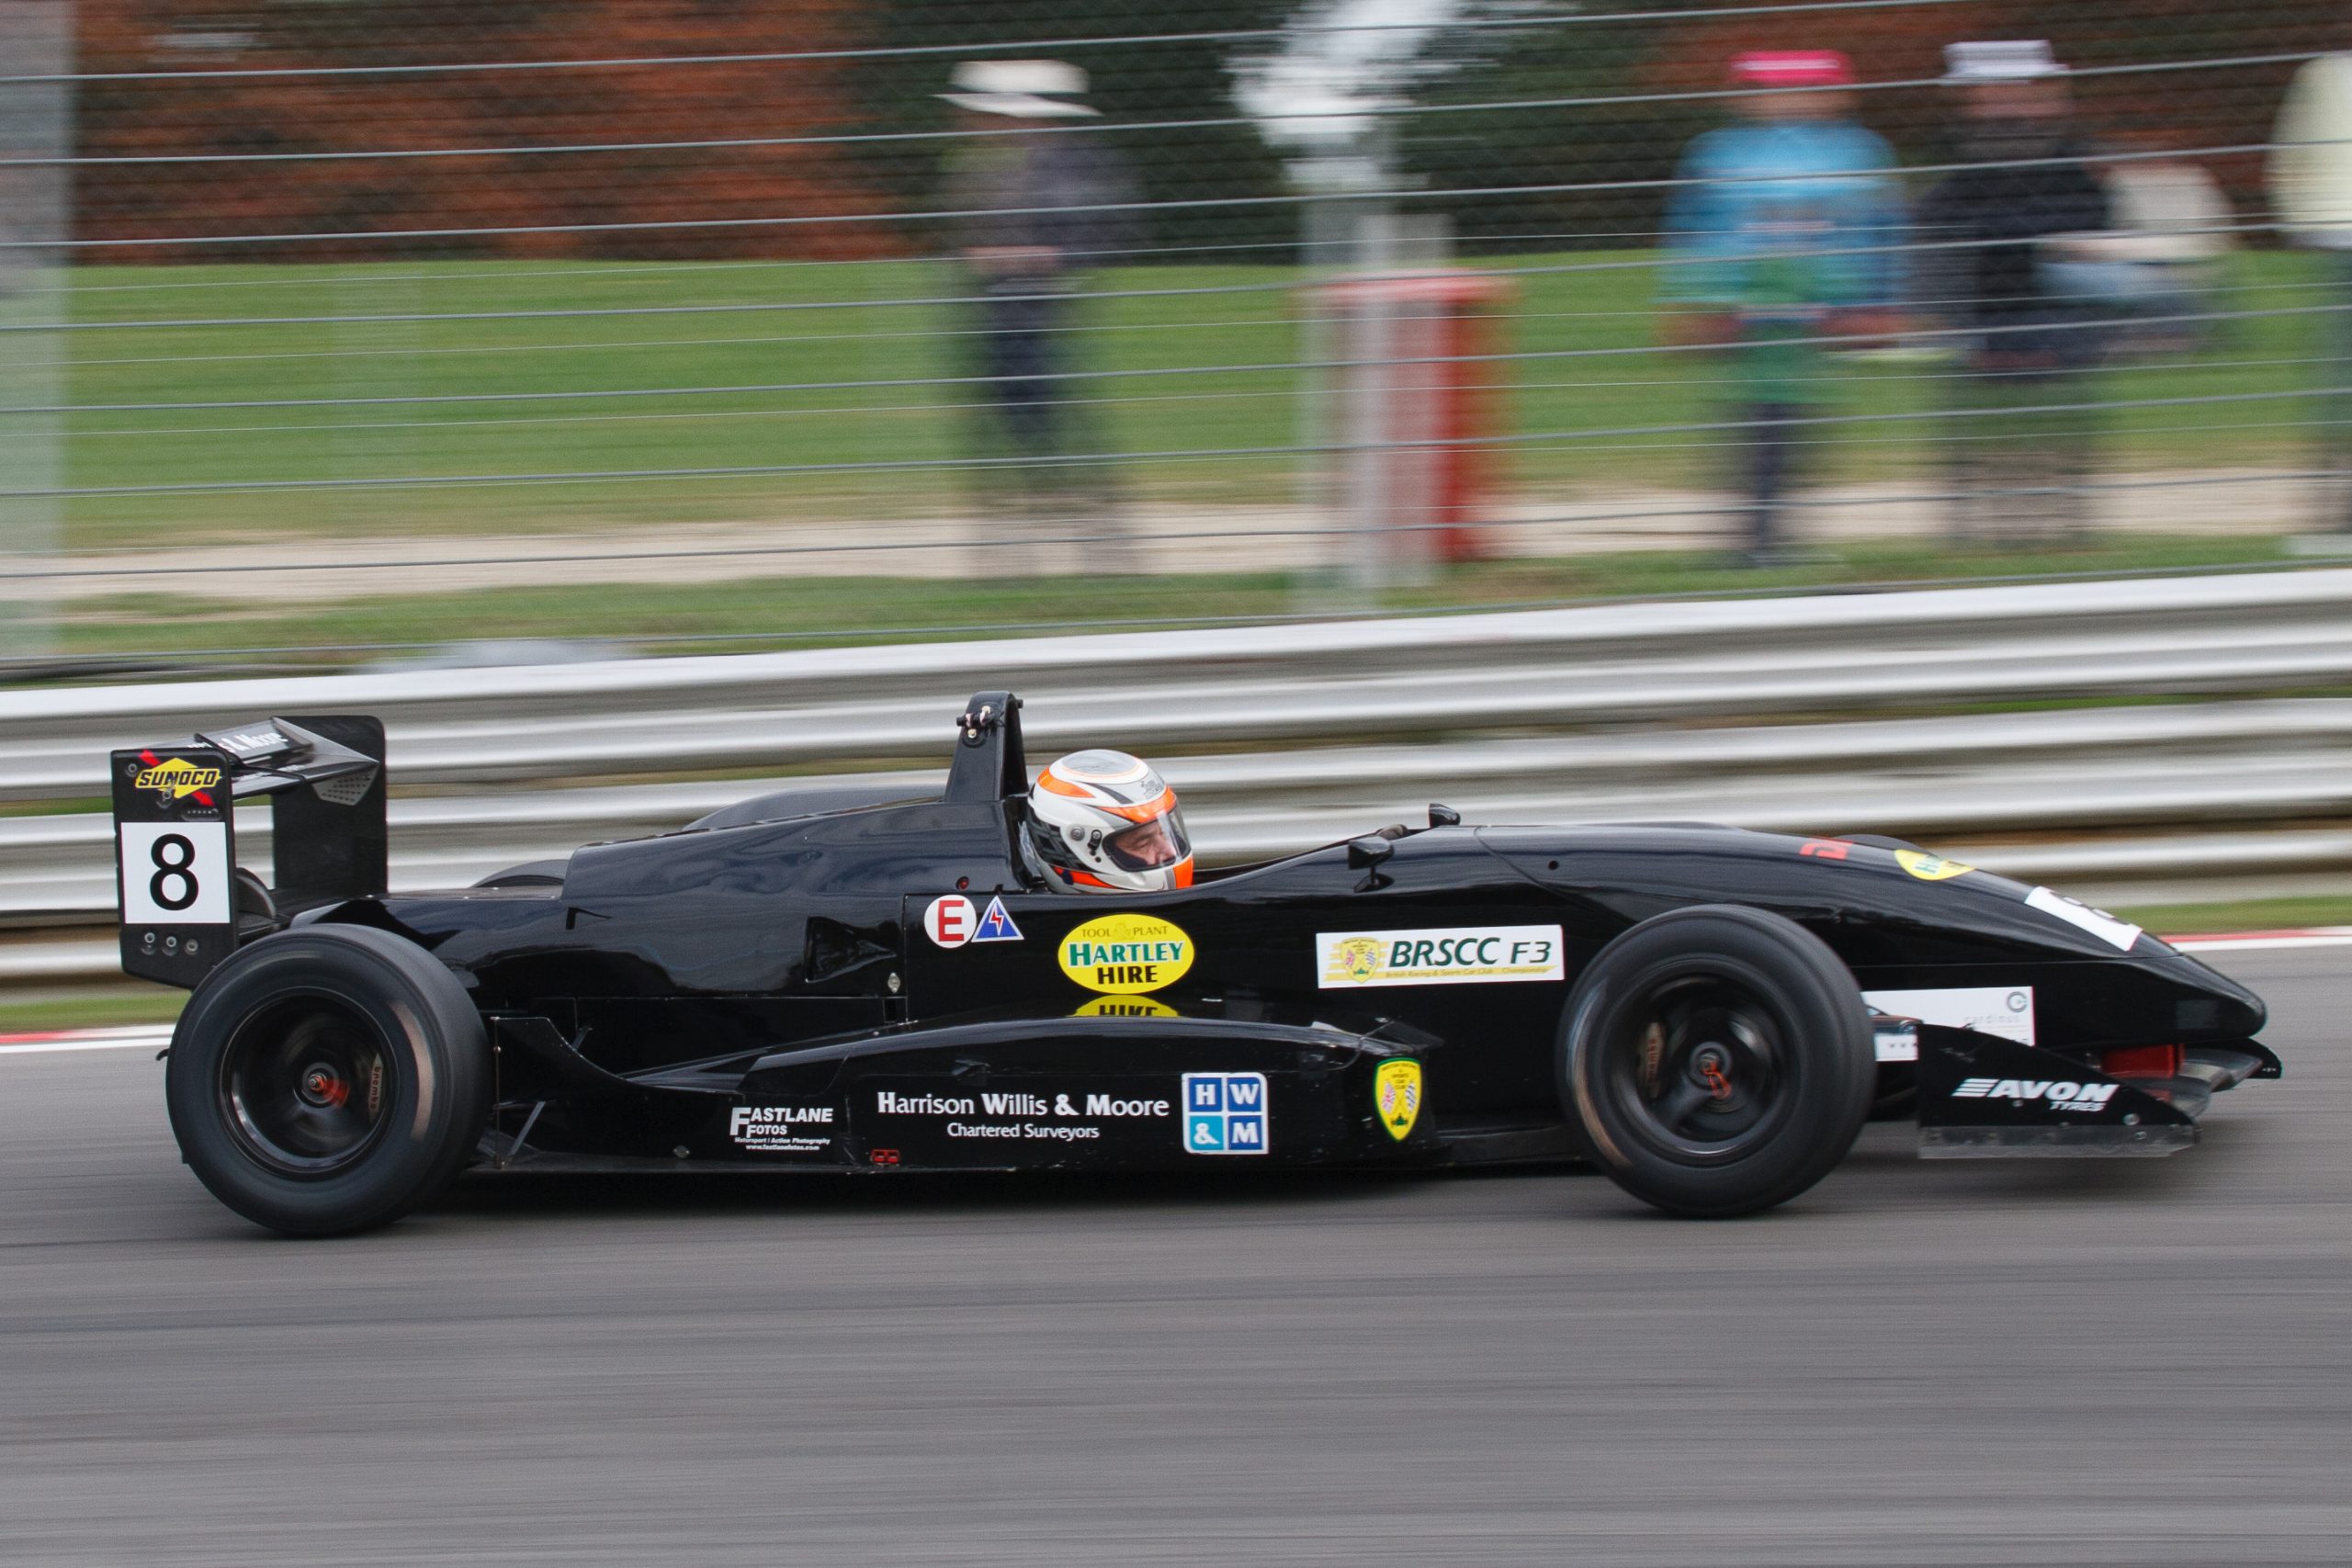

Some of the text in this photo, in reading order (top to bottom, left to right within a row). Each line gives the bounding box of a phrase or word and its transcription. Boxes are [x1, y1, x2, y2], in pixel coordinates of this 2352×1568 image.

[138, 771, 218, 786] SUNOCO
[149, 833, 199, 911] 8
[938, 900, 965, 942] E
[1082, 928, 1111, 938] TOOL
[1133, 926, 1168, 936] PLANT
[1069, 942, 1184, 966] HARTLEY
[1388, 937, 1500, 968] BRSCC
[1510, 941, 1552, 964] F3
[1097, 965, 1158, 985] HIRE
[370, 1066, 382, 1110] brembo
[1195, 1084, 1260, 1105] H W
[1985, 1079, 2120, 1102] AVON
[877, 1092, 1170, 1117] Harrison Willis & Moore
[2050, 1101, 2106, 1111] TYRES
[729, 1107, 833, 1135] FASTLANE
[746, 1124, 788, 1138] FOTOS
[947, 1122, 1100, 1142] Chartered Surveyors
[1193, 1122, 1260, 1145] & M
